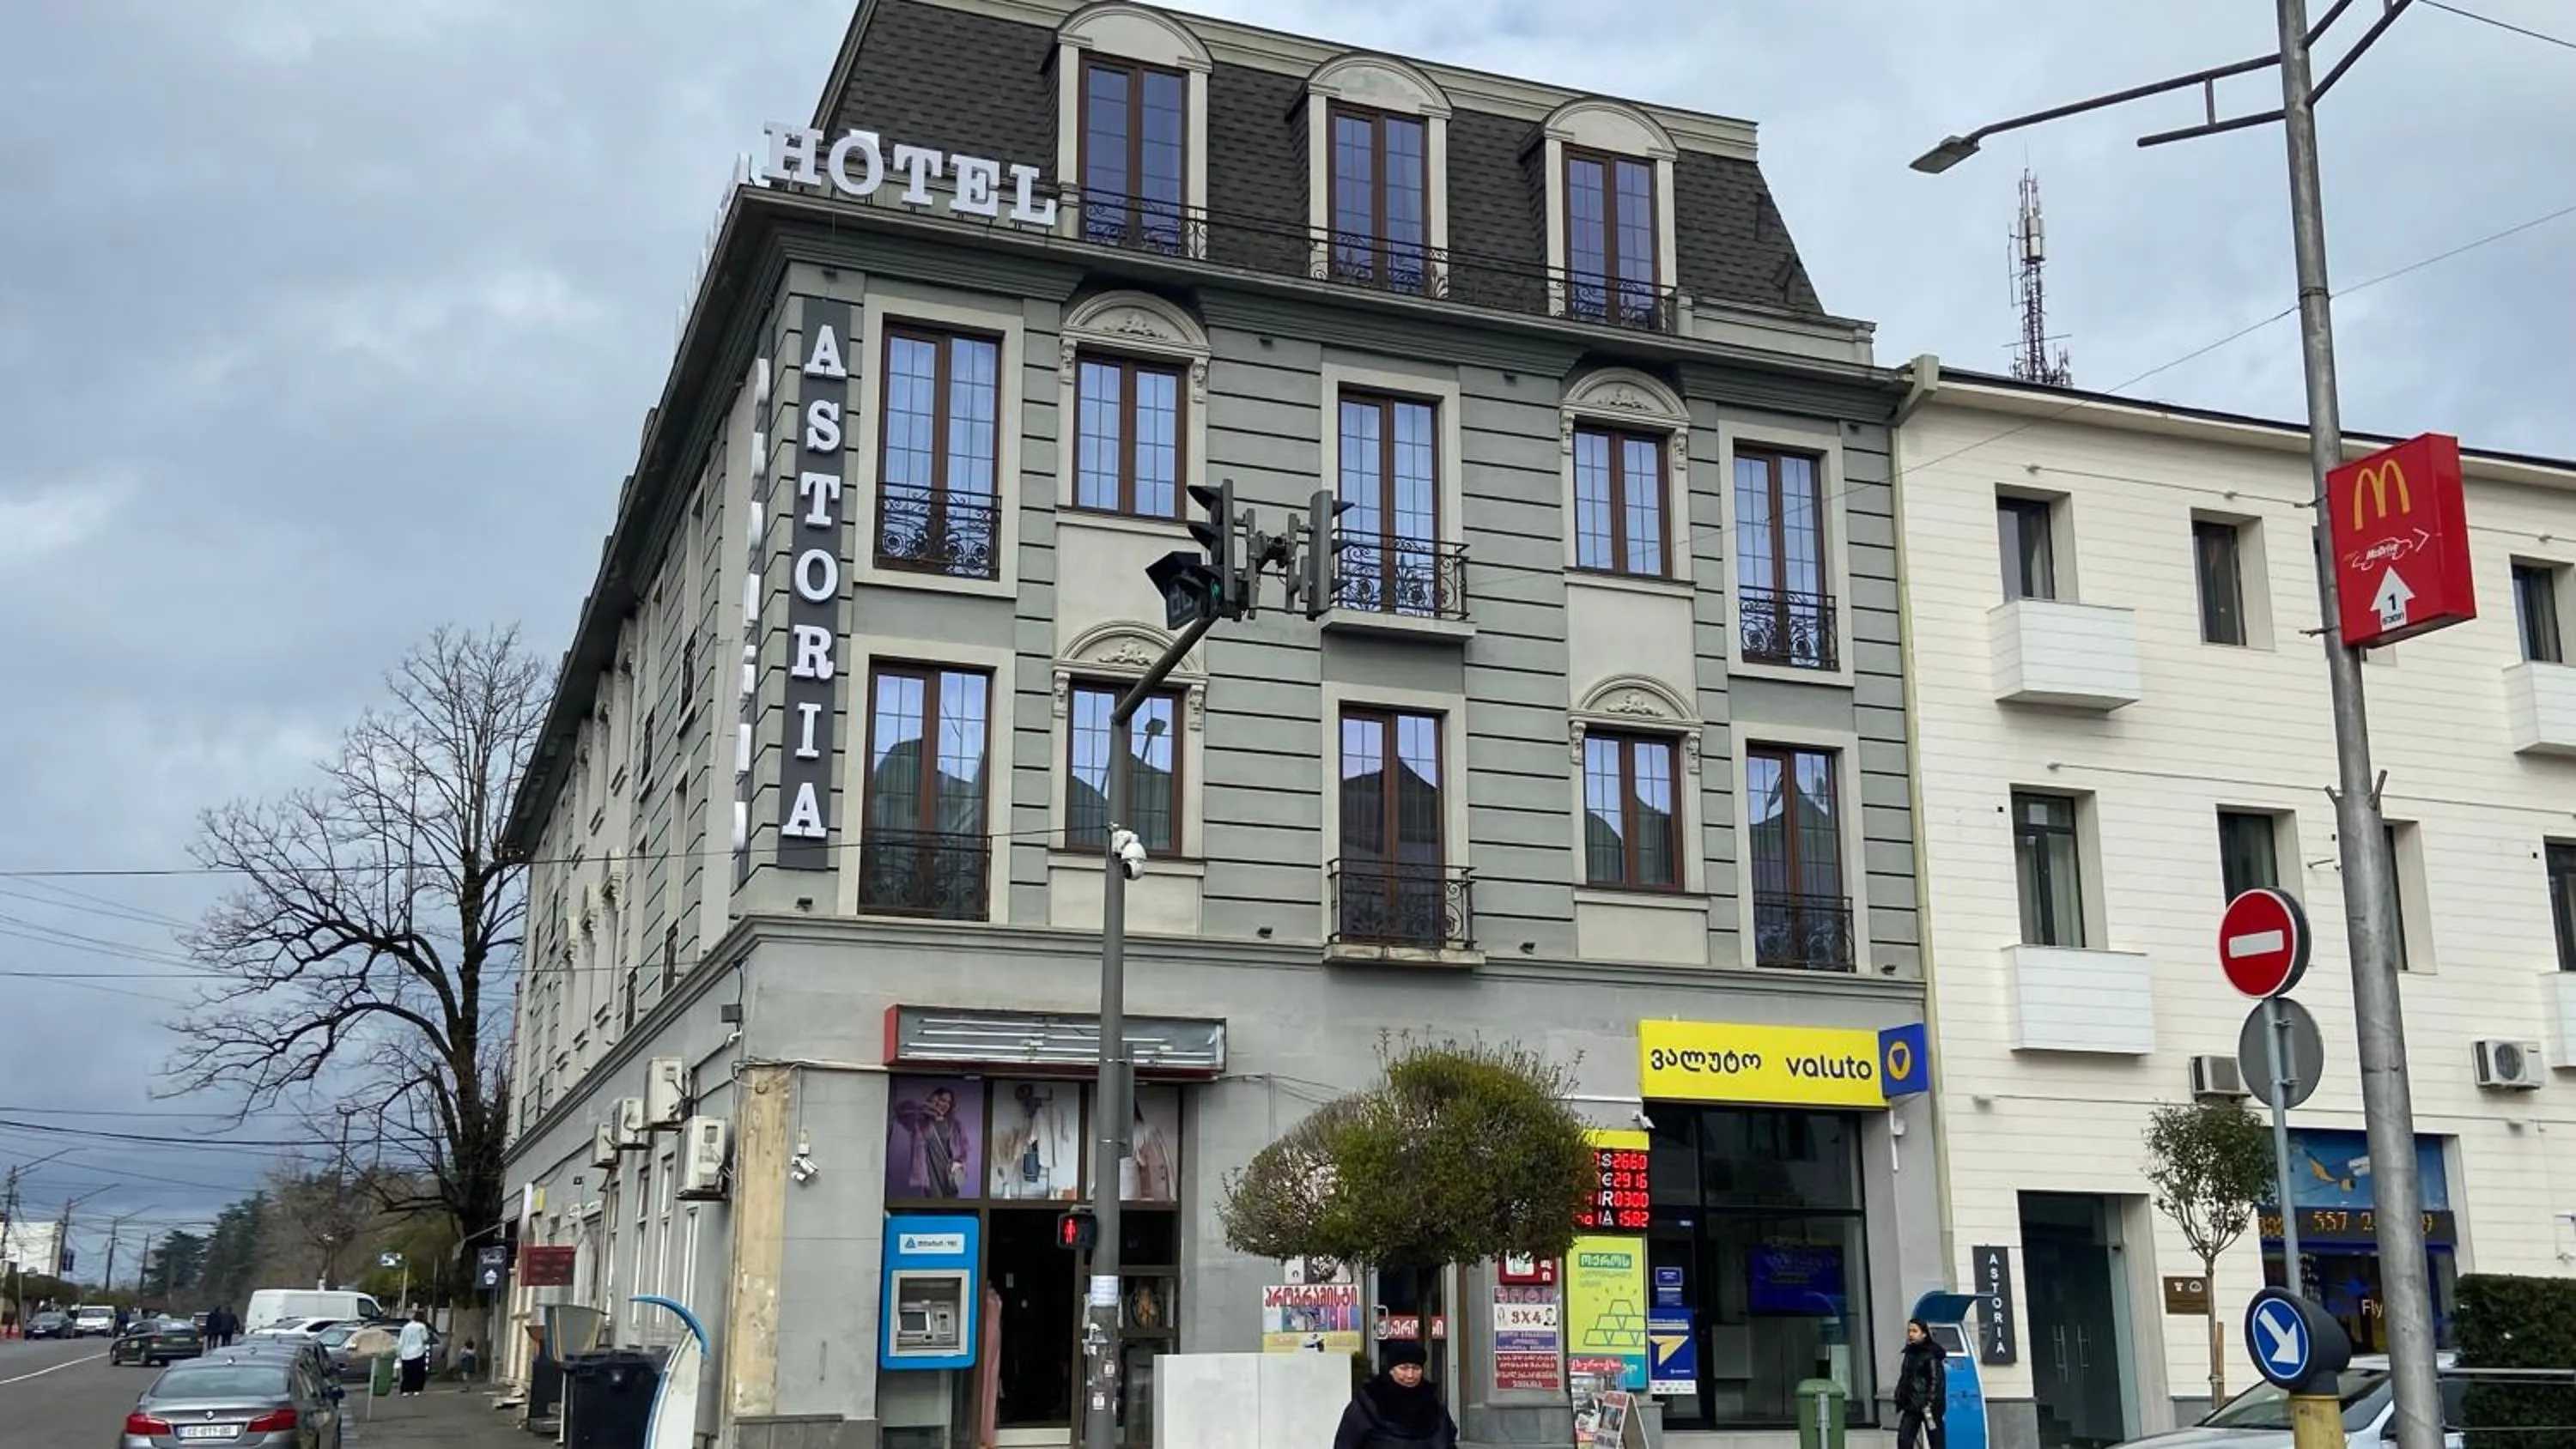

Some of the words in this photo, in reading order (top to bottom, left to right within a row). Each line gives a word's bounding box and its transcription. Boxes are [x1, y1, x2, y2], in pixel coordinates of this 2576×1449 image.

[762, 122, 1057, 226] HOTEL
[781, 324, 848, 839] ASTORIA
[2388, 592, 2397, 610] 1
[1650, 1048, 1762, 1074] ვალუტო
[1786, 1054, 1873, 1080] valuto
[1613, 1153, 1648, 1169] 2660
[1614, 1173, 1648, 1188] 2916
[1989, 1252, 2005, 1354] ASTORIA
[2361, 1300, 2383, 1319] Fly
